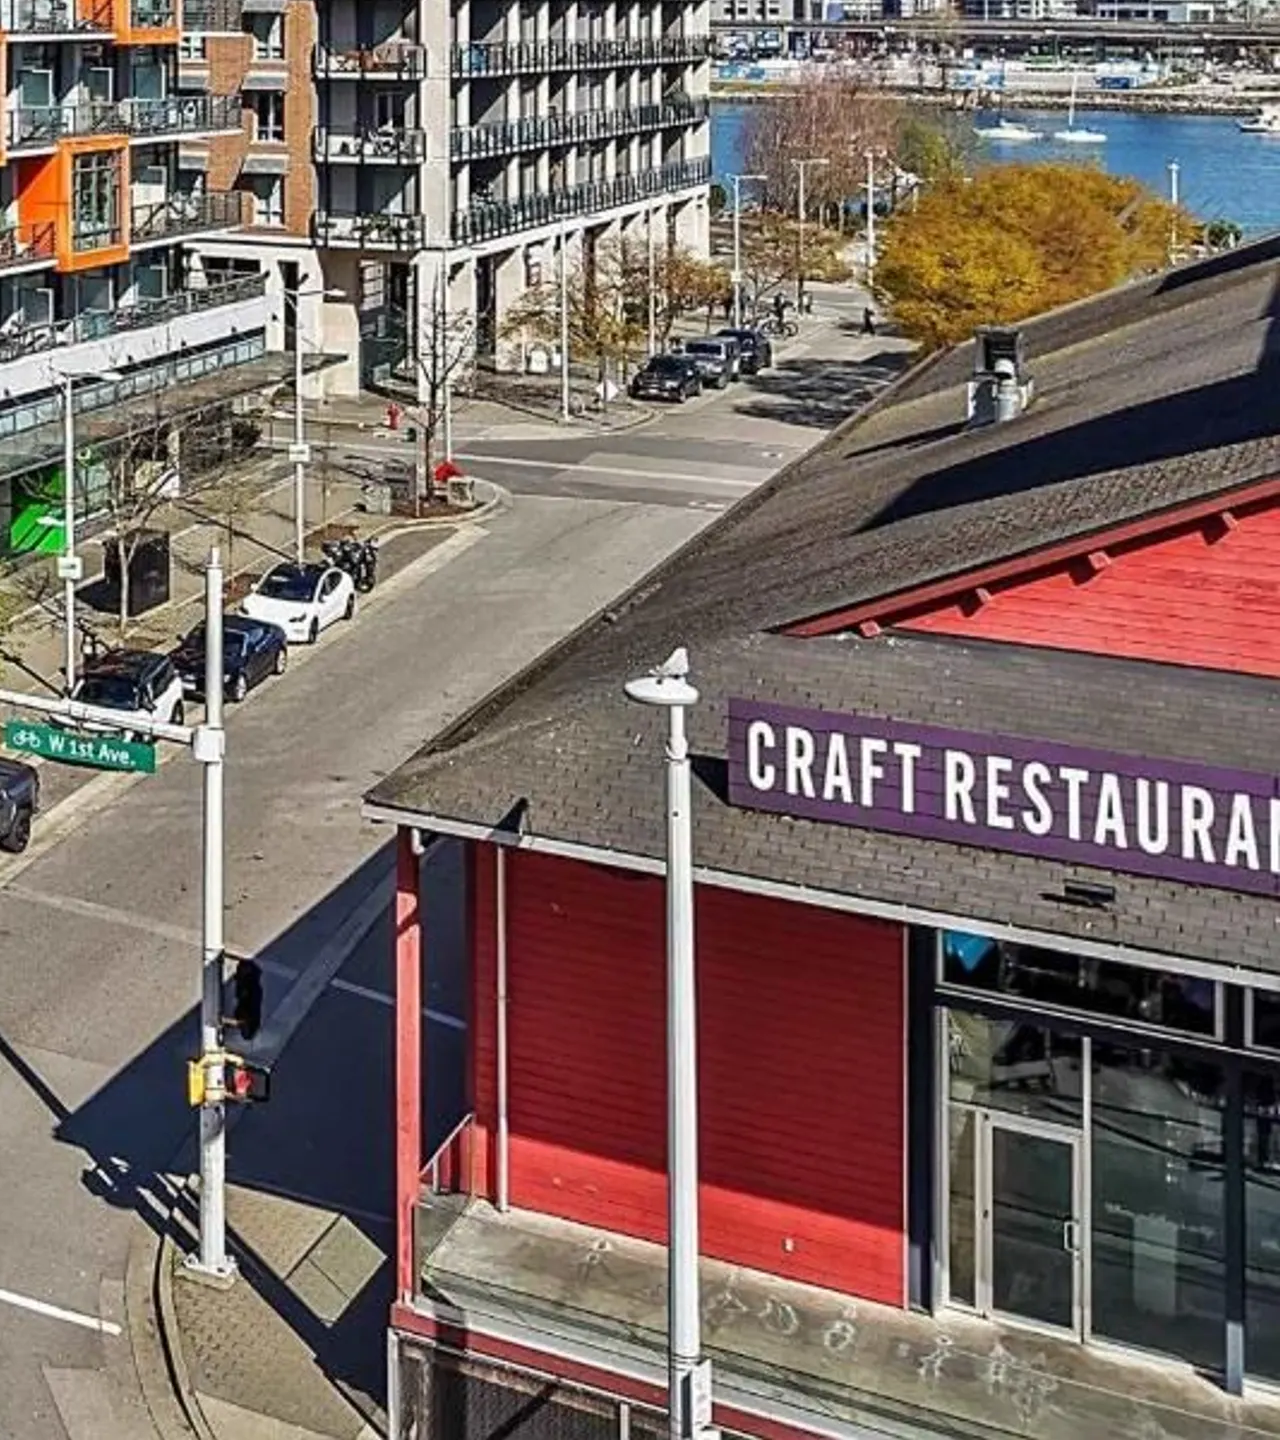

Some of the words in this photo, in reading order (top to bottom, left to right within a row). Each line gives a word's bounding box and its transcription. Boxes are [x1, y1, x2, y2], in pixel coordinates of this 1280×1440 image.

[48, 734, 65, 753] W
[69, 739, 94, 758] 1st
[746, 720, 922, 813] CRAFT
